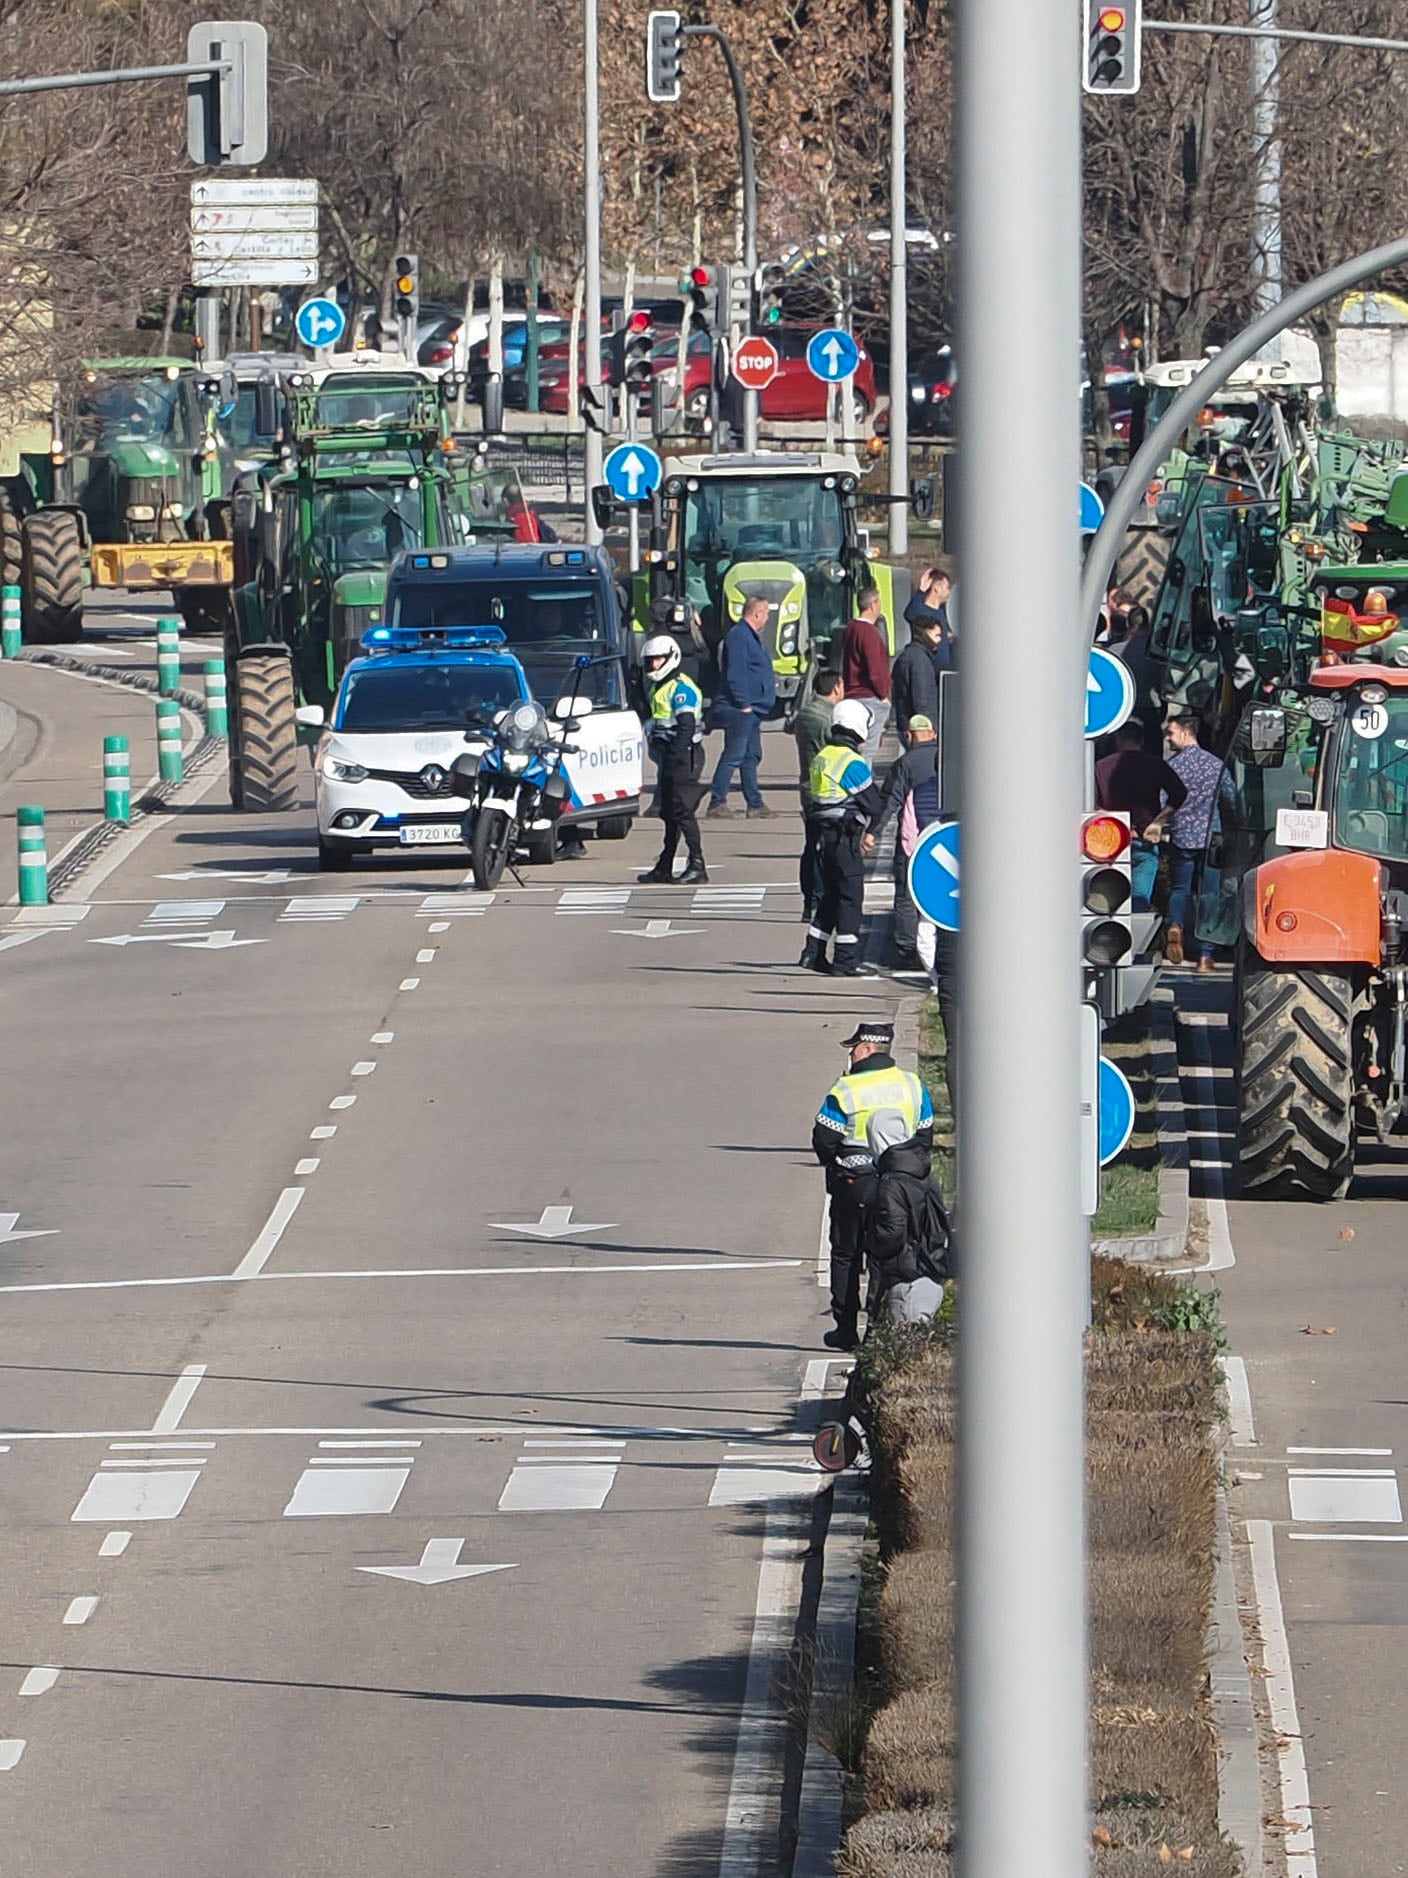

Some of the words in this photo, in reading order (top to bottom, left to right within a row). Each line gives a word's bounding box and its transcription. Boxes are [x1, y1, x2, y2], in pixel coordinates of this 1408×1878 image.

[739, 356, 773, 370] STOP
[1359, 709, 1380, 731] 50
[578, 745, 634, 769] Policía
[408, 827, 440, 841] 3720
